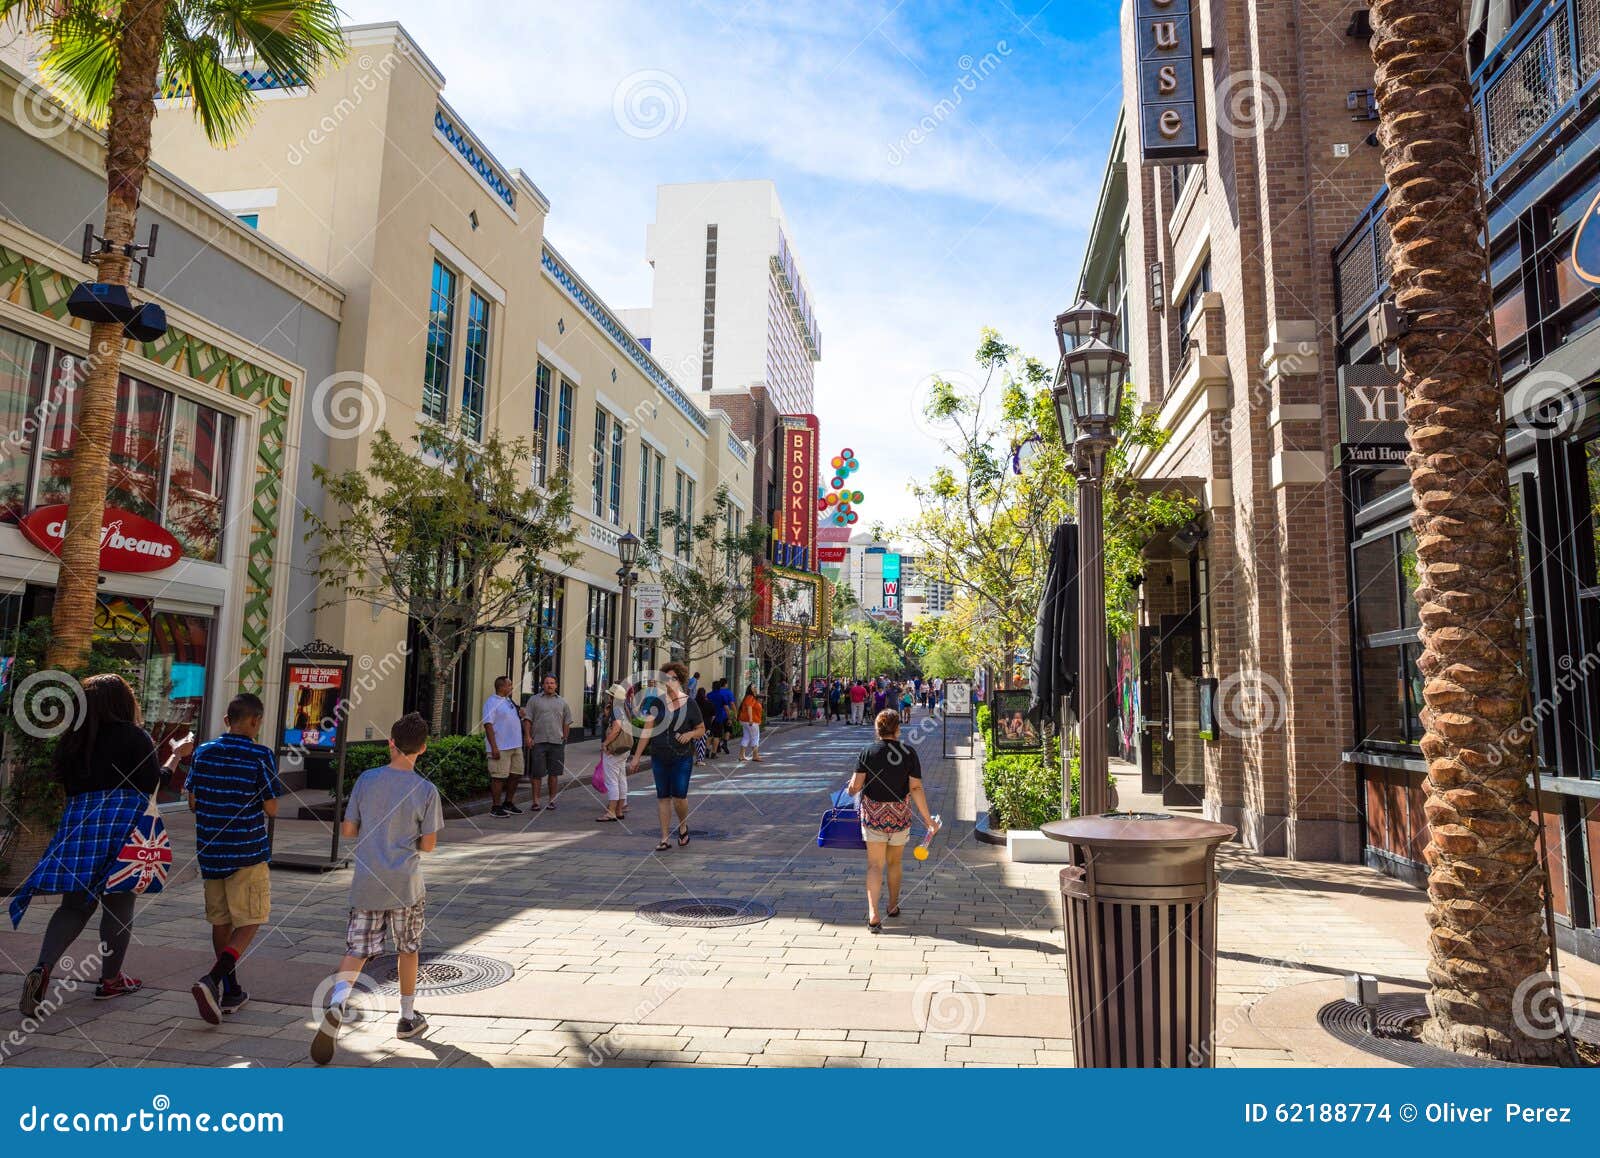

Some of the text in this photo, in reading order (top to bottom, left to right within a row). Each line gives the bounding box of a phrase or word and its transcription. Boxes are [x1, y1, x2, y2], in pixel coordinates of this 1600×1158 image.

[1151, 0, 1181, 138] use
[1348, 386, 1406, 422] YH
[1347, 446, 1376, 461] Yard
[792, 434, 804, 546] BROOKLY
[109, 530, 173, 558] beans
